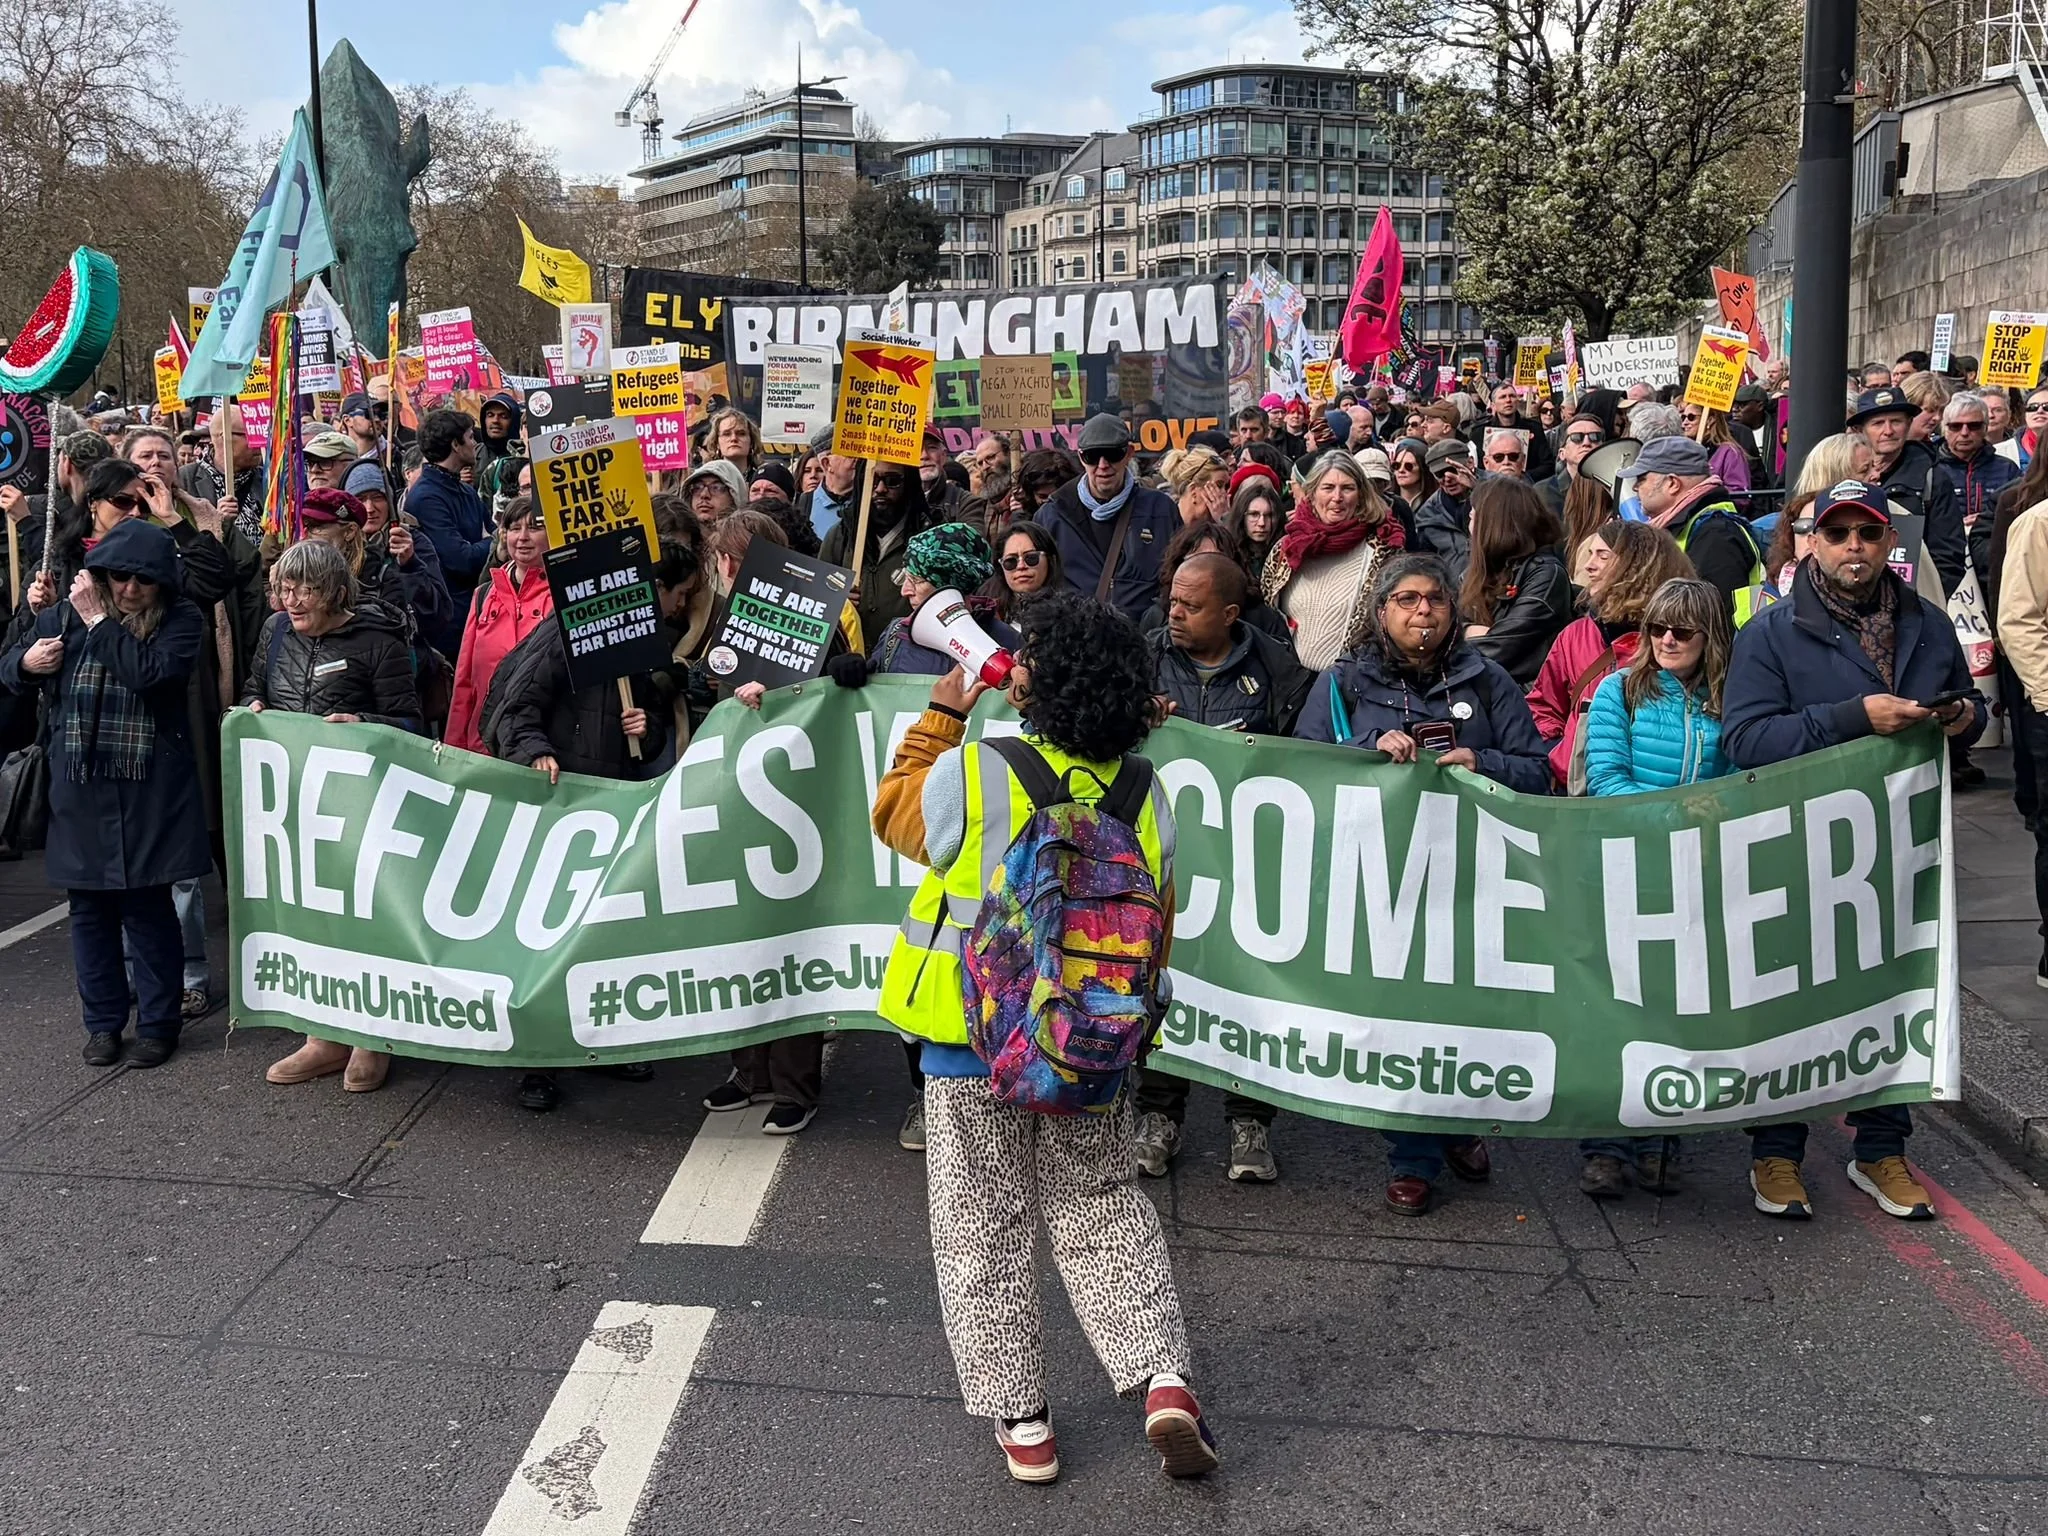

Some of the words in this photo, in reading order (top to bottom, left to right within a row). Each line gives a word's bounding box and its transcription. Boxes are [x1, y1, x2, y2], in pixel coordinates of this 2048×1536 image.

[1728, 281, 1750, 307] LOVE
[645, 292, 721, 331] ELY
[732, 284, 1219, 364] BIRMINGHAM
[1995, 325, 2031, 337] STOP
[426, 341, 473, 356] Refugees
[861, 332, 894, 344] Socialist
[893, 335, 921, 347] Worker
[1589, 344, 1613, 359] MY
[1627, 338, 1676, 353] CHILD
[1994, 337, 2019, 349] THE
[1522, 346, 1542, 354] STOP
[1991, 349, 2016, 361] FAR
[428, 354, 472, 369] welcome
[995, 366, 1015, 375] STOP
[1020, 366, 1036, 374] THE
[1520, 361, 1535, 369] FAR
[1700, 354, 1725, 369] Together
[1989, 361, 2032, 374] RIGHT
[428, 369, 453, 381] here
[616, 371, 679, 390] Refugees
[981, 377, 1006, 390] MEGA
[1013, 376, 1050, 390] YACHTS
[1694, 375, 1704, 384] the
[1705, 377, 1714, 386] far
[1715, 380, 1732, 392] right
[1706, 368, 1716, 377] can
[1718, 371, 1734, 383] stop
[849, 376, 900, 396] Together
[618, 391, 679, 410] welcome
[1000, 392, 1015, 400] NOT
[846, 397, 861, 408] we
[866, 398, 886, 411] can
[891, 399, 917, 419] stop
[981, 405, 1013, 419] SMALL
[1020, 403, 1050, 418] BOATS
[655, 416, 679, 434] the
[844, 410, 863, 425] the
[867, 411, 885, 427] far
[888, 415, 917, 434] right
[570, 428, 596, 441] STAND
[597, 425, 609, 434] UP
[572, 441, 583, 450] TO
[585, 432, 616, 447] RACISM
[842, 428, 867, 440] Smash
[870, 431, 881, 443] the
[884, 432, 915, 448] fascists
[646, 438, 679, 460] right
[840, 440, 876, 454] Refugees
[878, 445, 911, 459] welcome
[549, 448, 614, 483] STOP
[553, 476, 603, 507] THE
[559, 501, 607, 532] FAR
[565, 579, 597, 602] WE
[601, 566, 639, 592] ARE
[565, 587, 649, 625] TOGETHER
[749, 577, 783, 604] WE
[783, 592, 828, 619] ARE
[569, 613, 626, 641] AGAINST
[627, 605, 655, 621] THE
[738, 598, 824, 639] TOGETHER
[571, 635, 606, 657] FAR
[607, 619, 657, 646] RIGHT
[727, 614, 790, 646] AGAINST
[792, 638, 820, 658] THE
[721, 628, 758, 653] FAR
[759, 643, 815, 673] RIGHT
[1602, 758, 1942, 1015] HERE
[255, 950, 498, 1032] #BrumUnited
[1163, 1000, 1534, 1102] grantJustice
